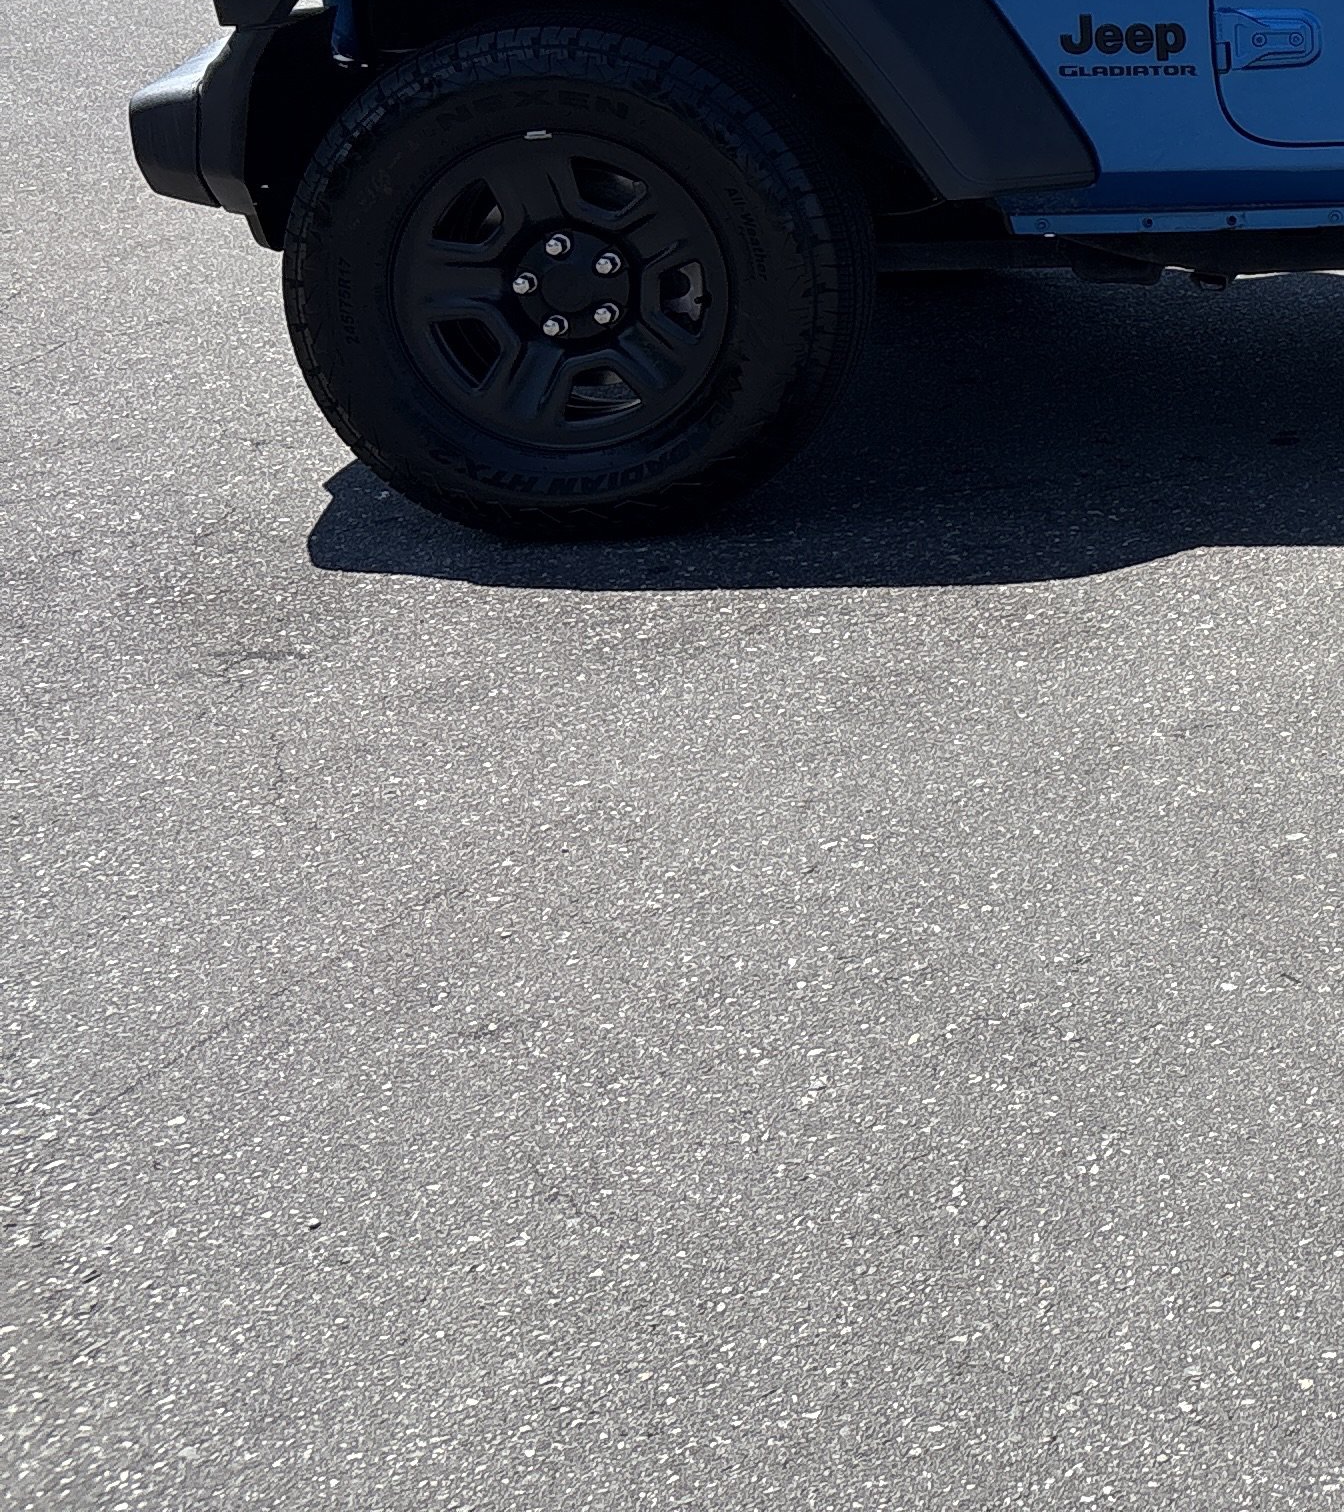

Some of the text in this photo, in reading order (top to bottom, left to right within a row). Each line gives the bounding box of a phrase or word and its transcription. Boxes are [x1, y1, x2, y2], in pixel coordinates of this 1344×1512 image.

[1060, 13, 1187, 61] Jeep
[1058, 65, 1199, 77] GLADIATOR
[436, 90, 629, 131] NEXEN
